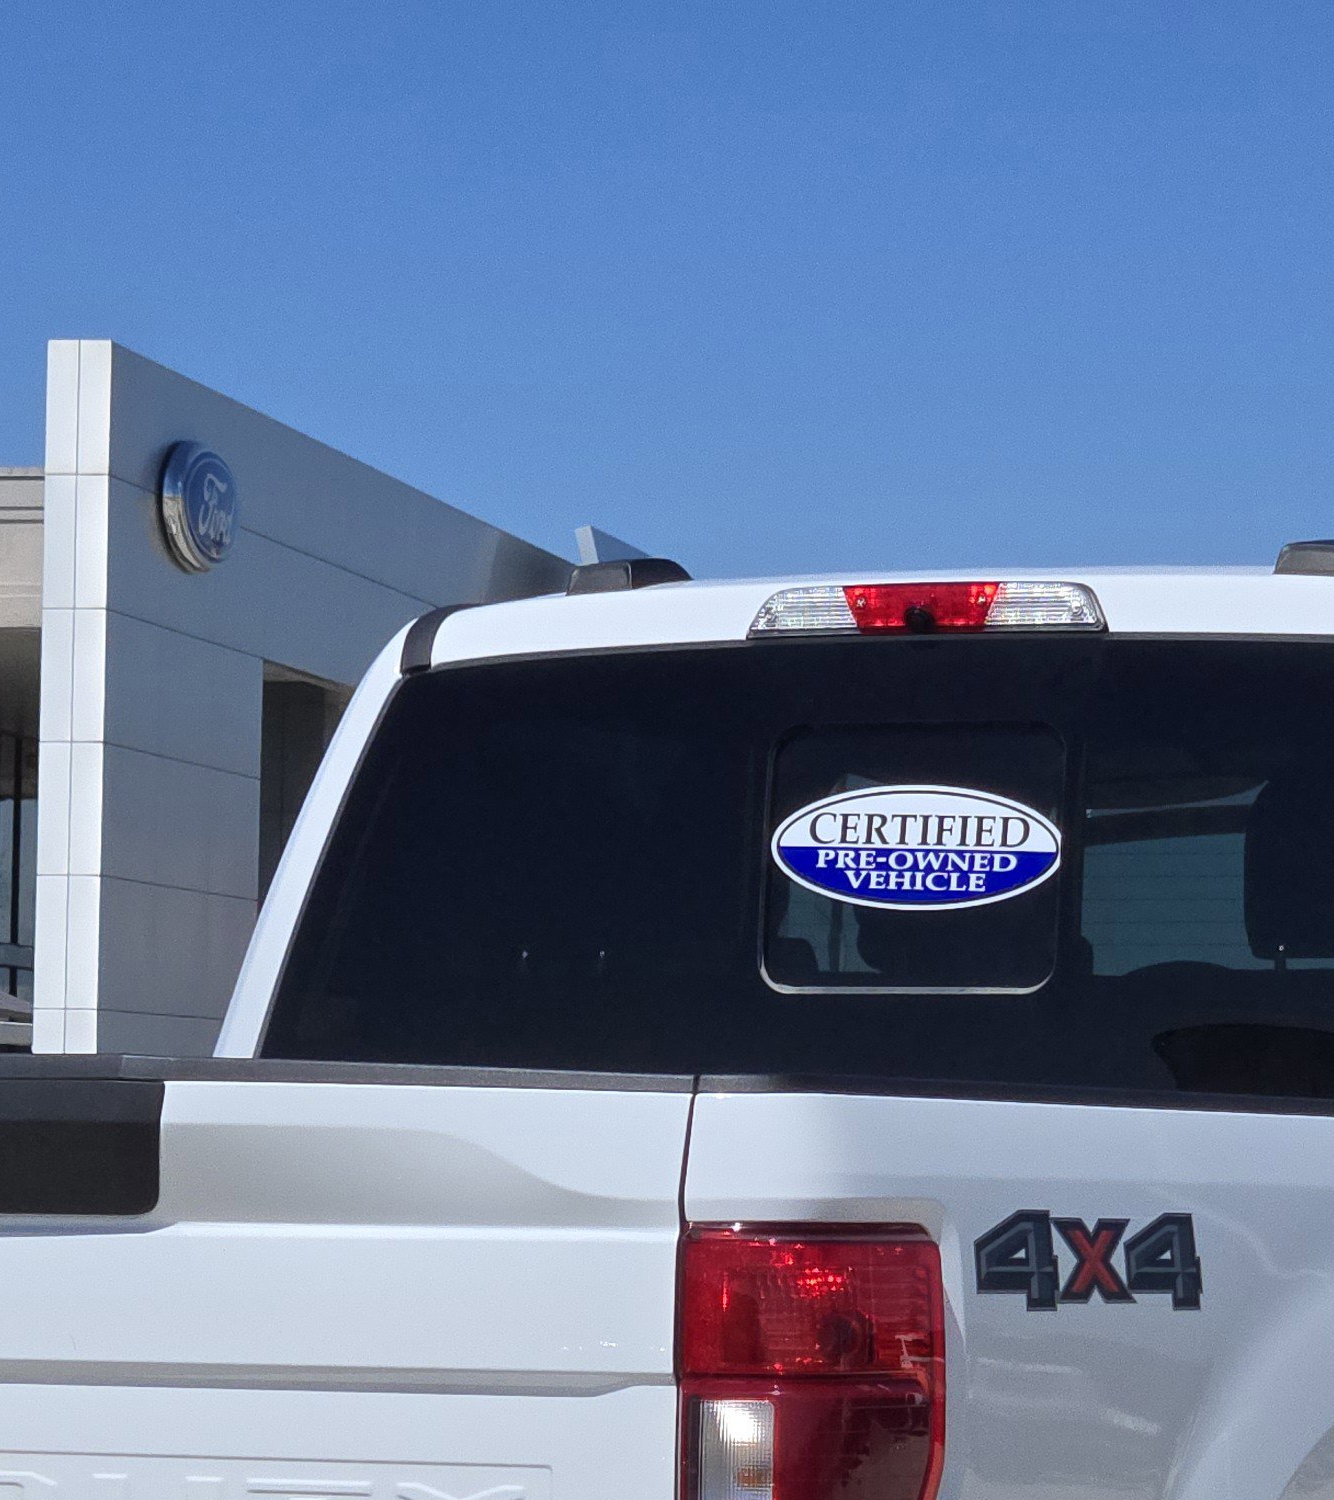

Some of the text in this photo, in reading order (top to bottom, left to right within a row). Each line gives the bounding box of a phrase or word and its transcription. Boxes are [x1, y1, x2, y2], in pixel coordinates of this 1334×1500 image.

[199, 473, 232, 545] Ford
[810, 812, 1031, 848] CERTIFIED
[816, 851, 1017, 872] PRE-OWNED
[844, 870, 986, 892] VEHICLE
